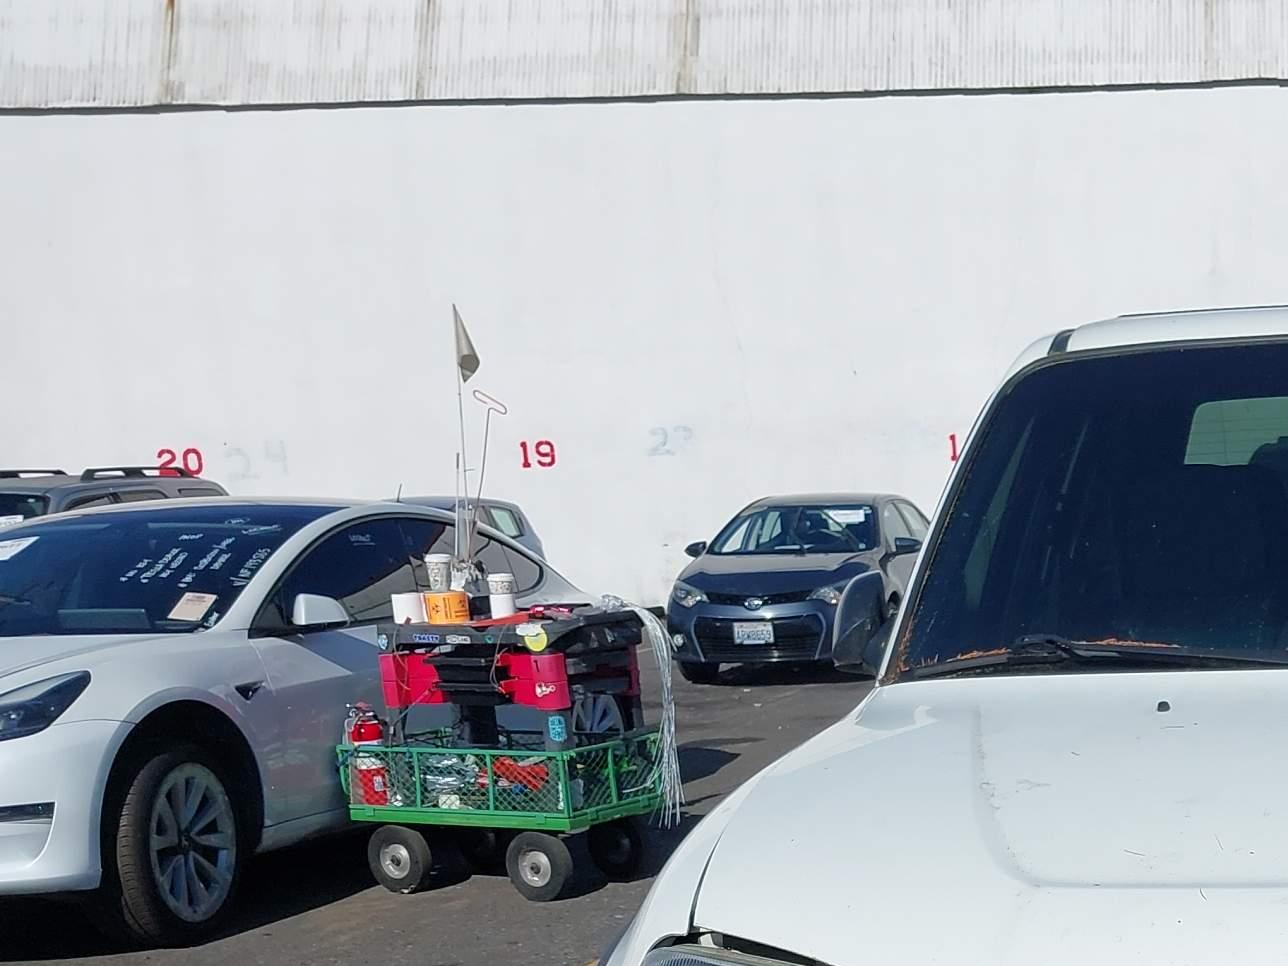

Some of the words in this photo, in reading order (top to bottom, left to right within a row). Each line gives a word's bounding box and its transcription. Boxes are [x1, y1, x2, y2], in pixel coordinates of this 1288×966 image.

[520, 440, 556, 468] 19
[950, 434, 958, 461] 1
[155, 447, 203, 479] 20
